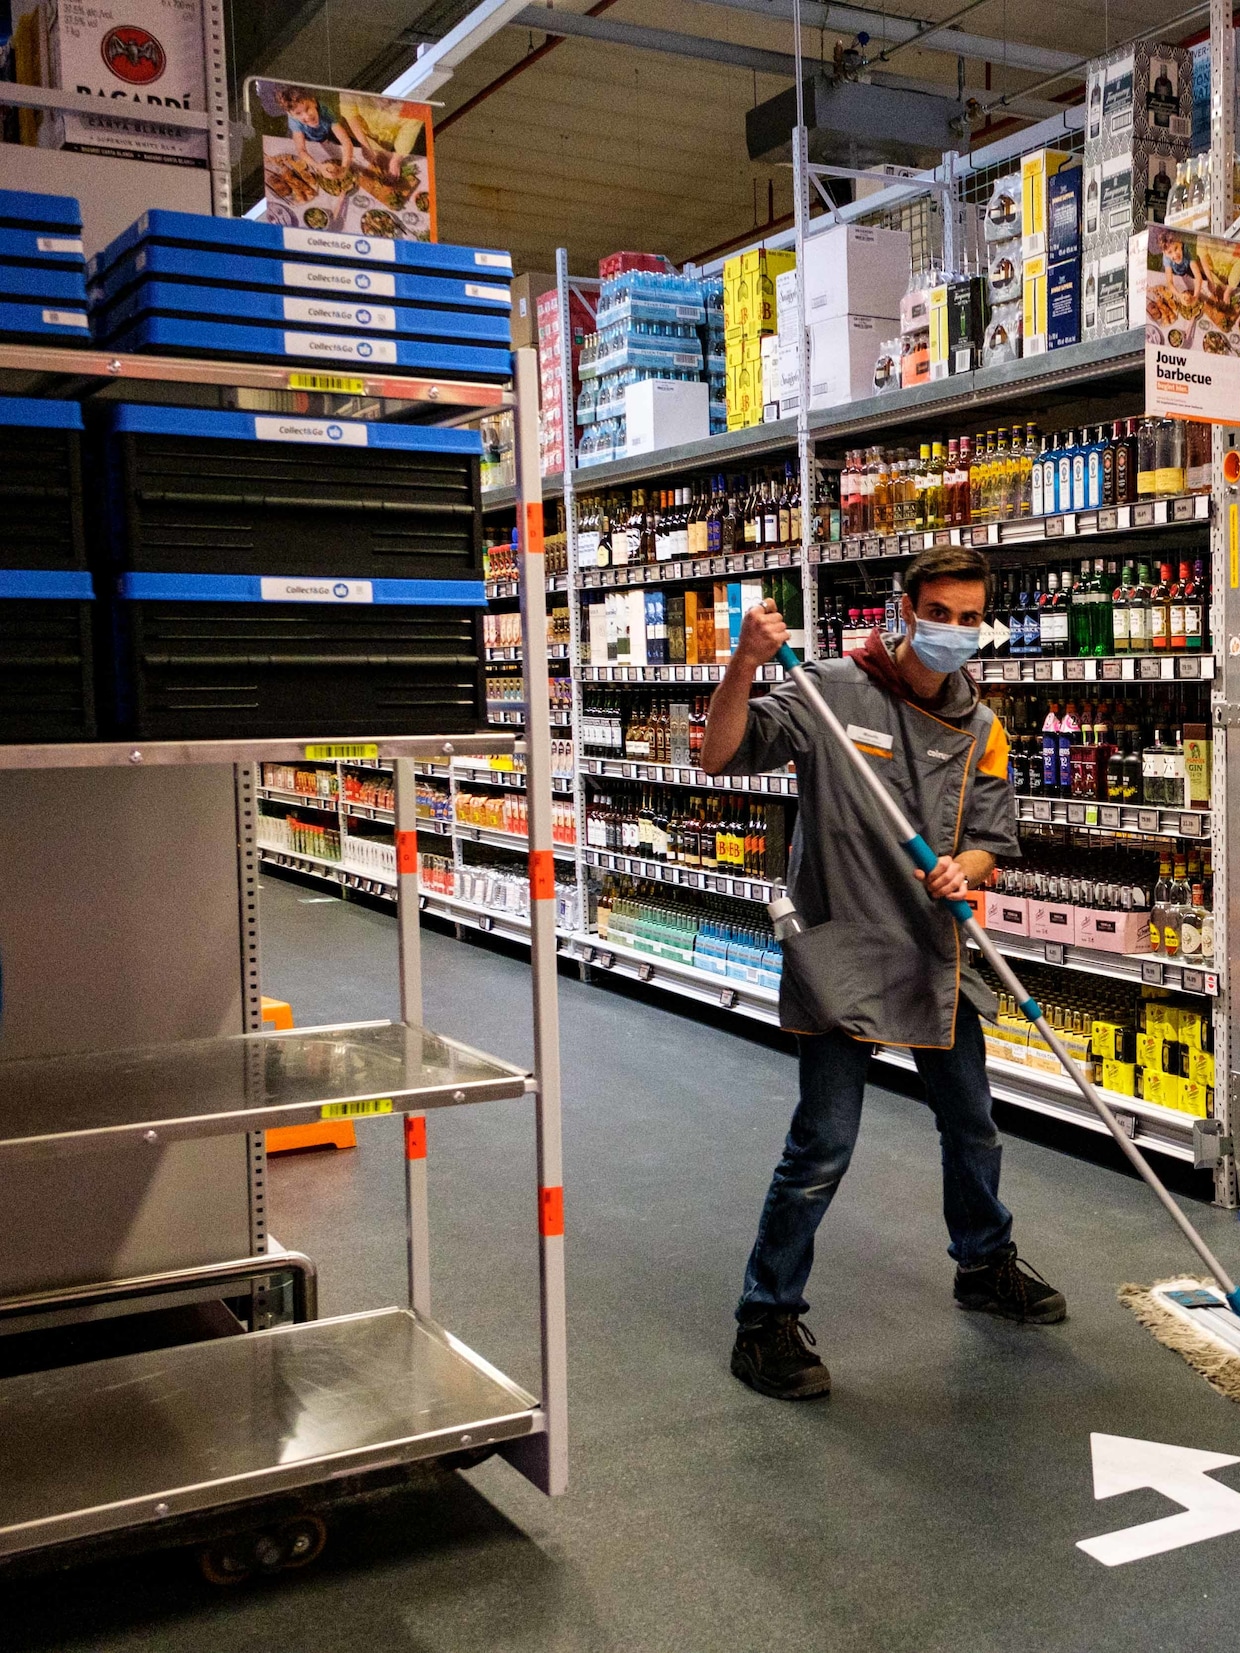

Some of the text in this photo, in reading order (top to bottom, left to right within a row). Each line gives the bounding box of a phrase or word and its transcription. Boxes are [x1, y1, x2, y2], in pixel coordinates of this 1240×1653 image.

[307, 237, 352, 250] Collect&Go
[1156, 351, 1187, 367] Jouw
[1156, 364, 1212, 385] barbecue
[279, 426, 323, 436] Collect&Go
[286, 585, 329, 596] Collect&Go
[1188, 764, 1203, 772] GIN
